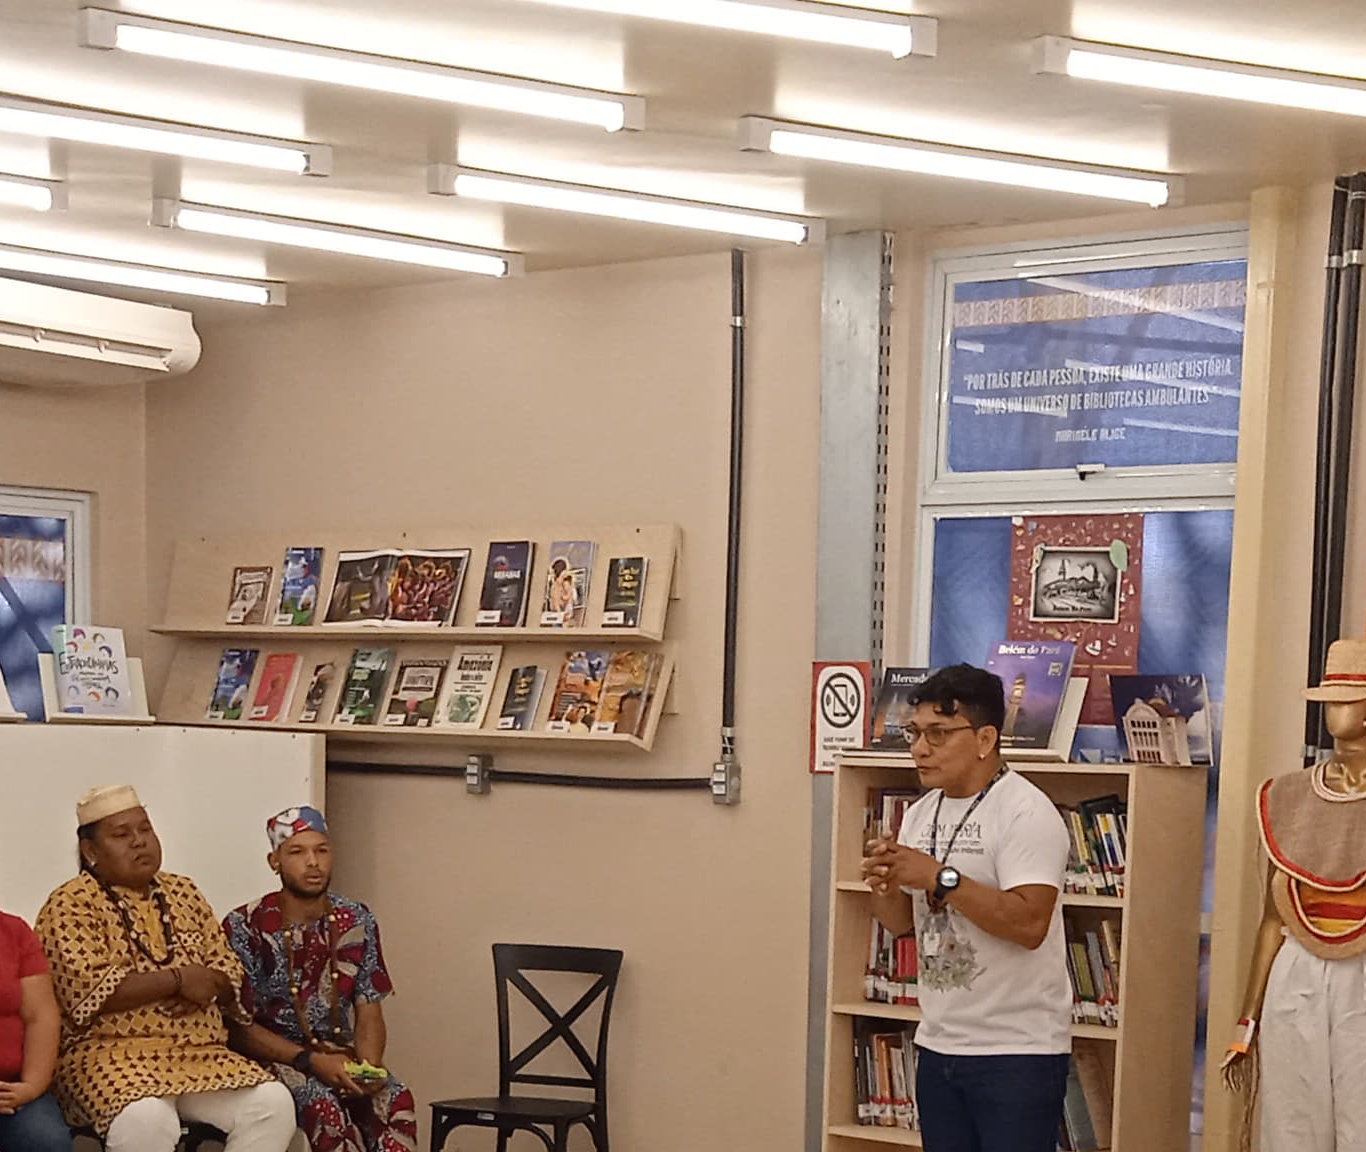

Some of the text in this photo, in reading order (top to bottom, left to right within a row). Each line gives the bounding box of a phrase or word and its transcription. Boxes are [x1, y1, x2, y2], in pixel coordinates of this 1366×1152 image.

[987, 369, 1010, 389] TRÁS
[1010, 369, 1023, 388] DE
[1023, 368, 1048, 387] CADA
[1089, 365, 1121, 384] EXISTE
[1121, 363, 1144, 380] UMA
[1145, 360, 1184, 380] GRANDE
[975, 397, 1008, 415] SOMOS
[1008, 396, 1023, 413] UM
[1024, 393, 1068, 413] UNIVERSO
[1069, 392, 1083, 411] DE
[1083, 388, 1145, 410] BIBLIOTECAS
